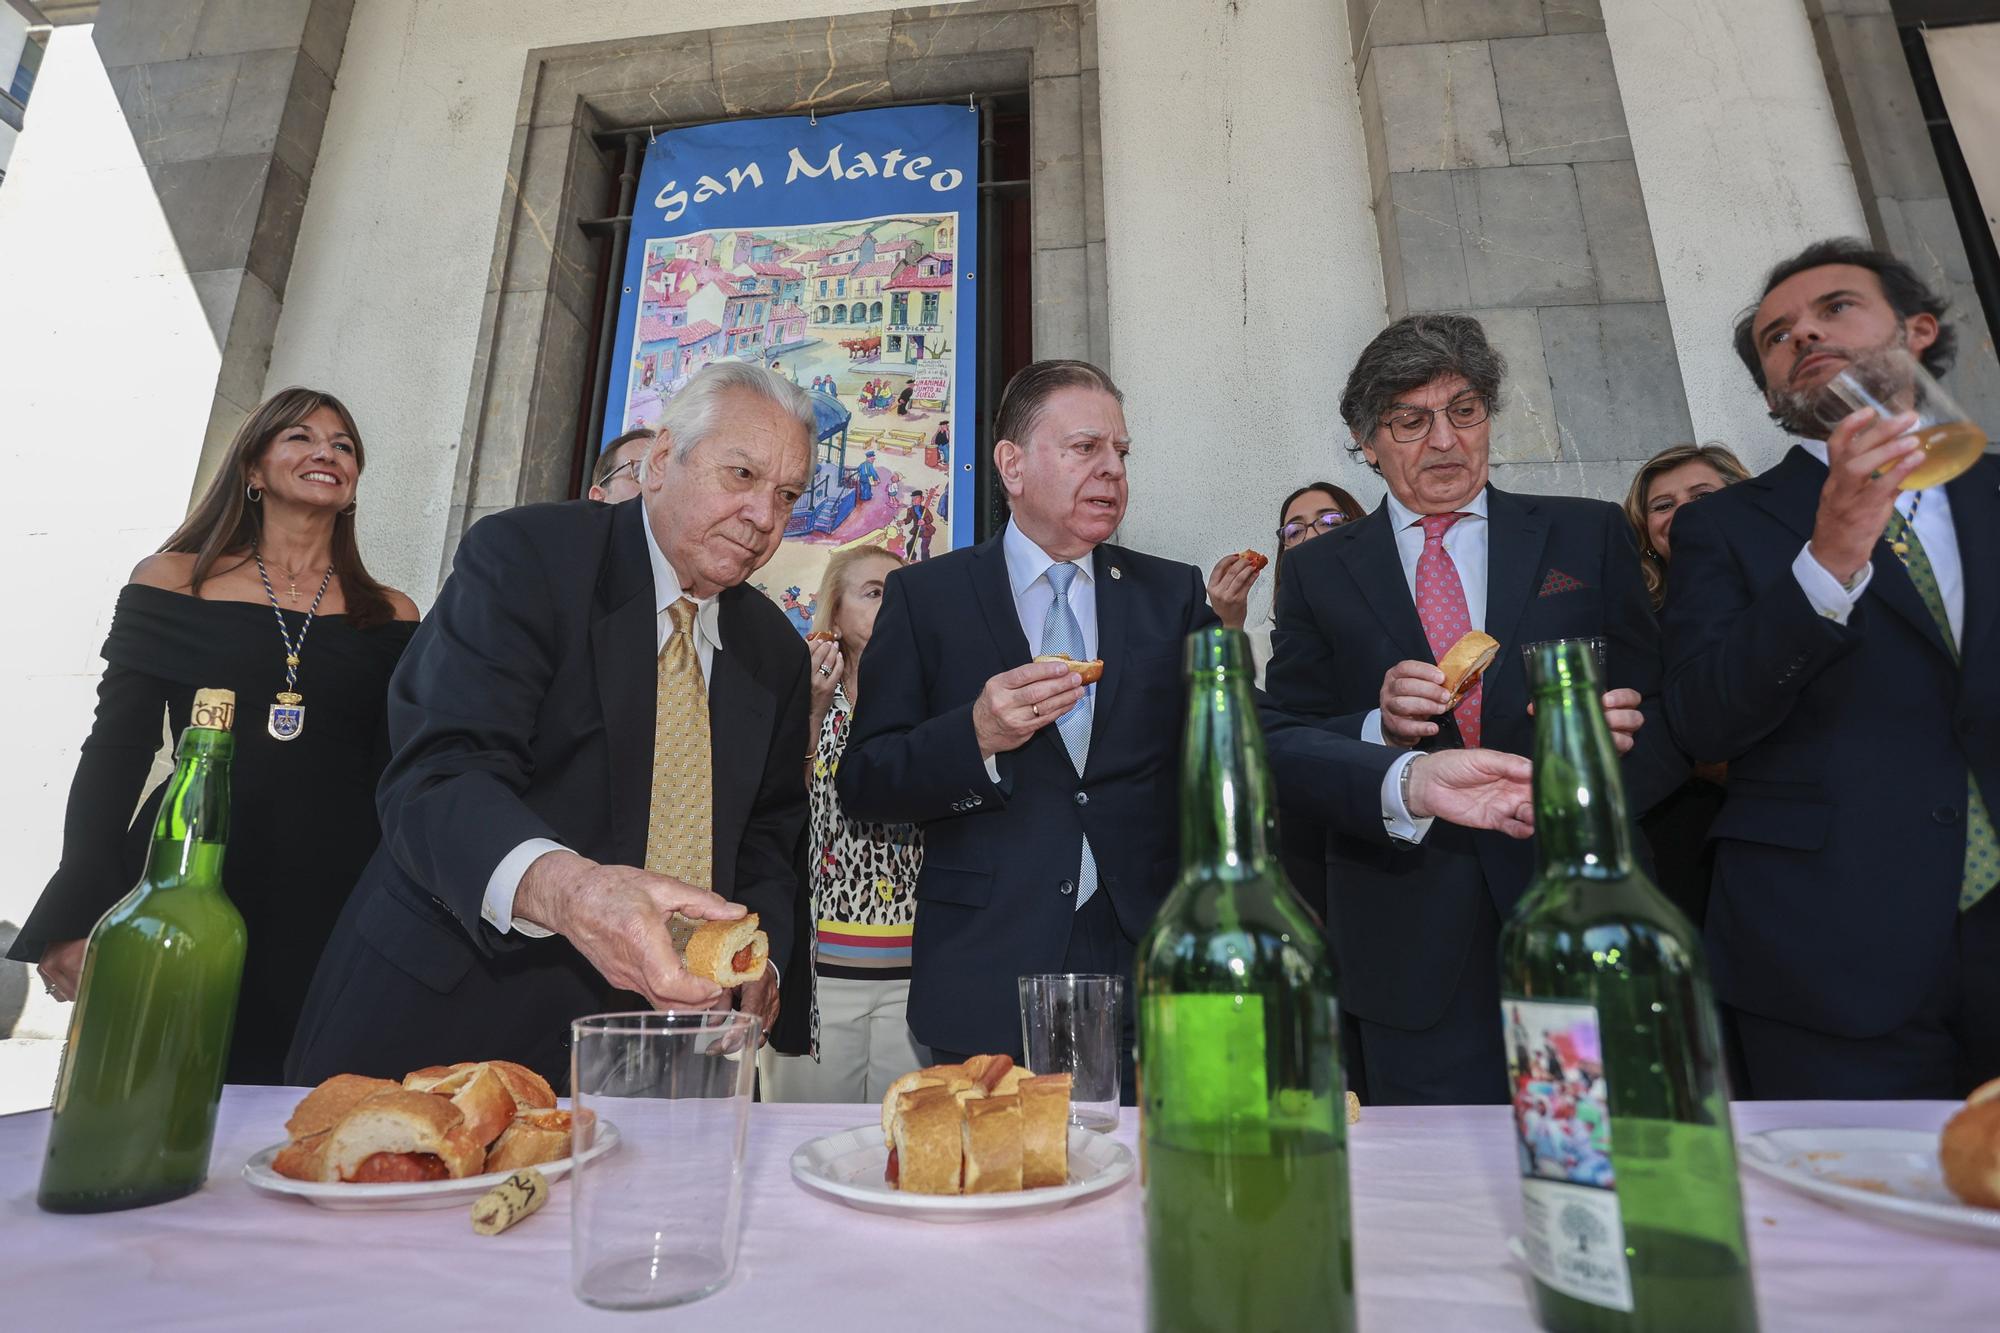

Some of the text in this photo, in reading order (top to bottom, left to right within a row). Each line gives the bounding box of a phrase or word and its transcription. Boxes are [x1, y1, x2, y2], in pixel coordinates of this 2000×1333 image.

[654, 143, 963, 222] San Mateo
[916, 391, 937, 399] SUELO.
